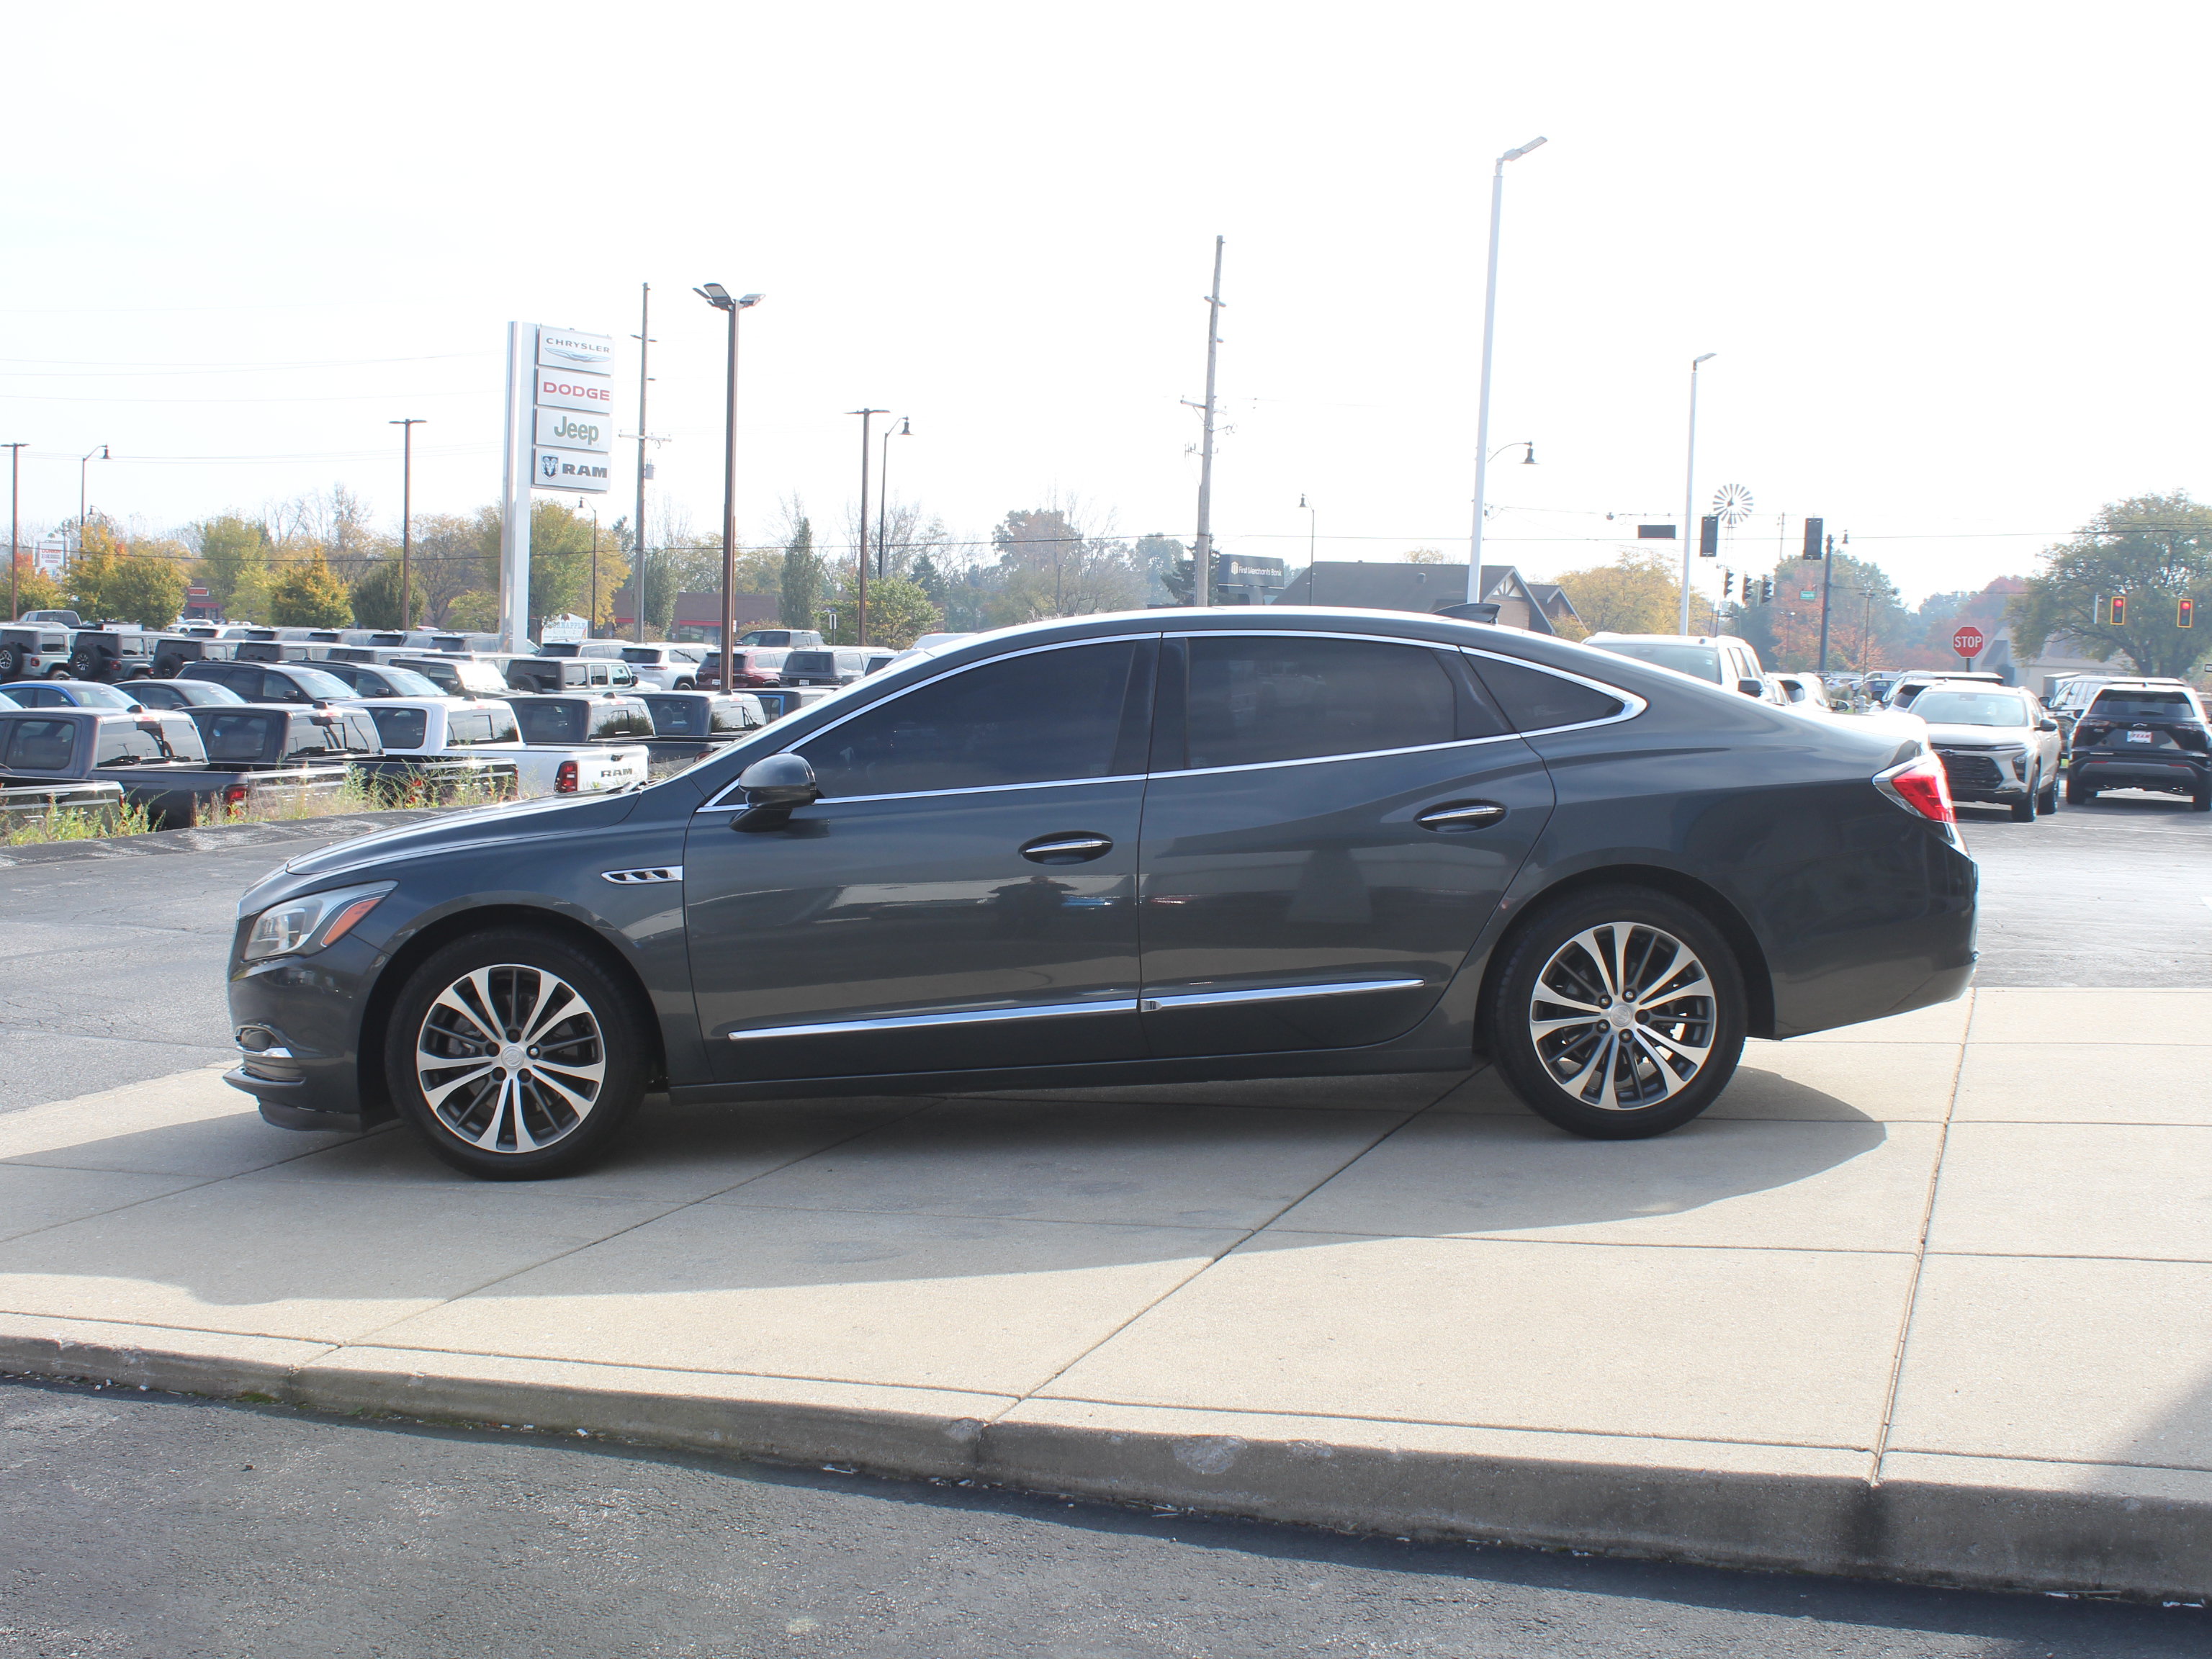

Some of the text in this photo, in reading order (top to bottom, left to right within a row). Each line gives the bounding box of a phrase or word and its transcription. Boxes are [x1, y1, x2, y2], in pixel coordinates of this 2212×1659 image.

[546, 338, 610, 353] CHRYSLER
[544, 382, 610, 401] DODGE
[554, 415, 599, 445] Jeep
[562, 463, 607, 478] RAM
[1248, 567, 1270, 575] Merchants
[1954, 636, 1982, 648] STOP
[601, 768, 633, 778] RAM
